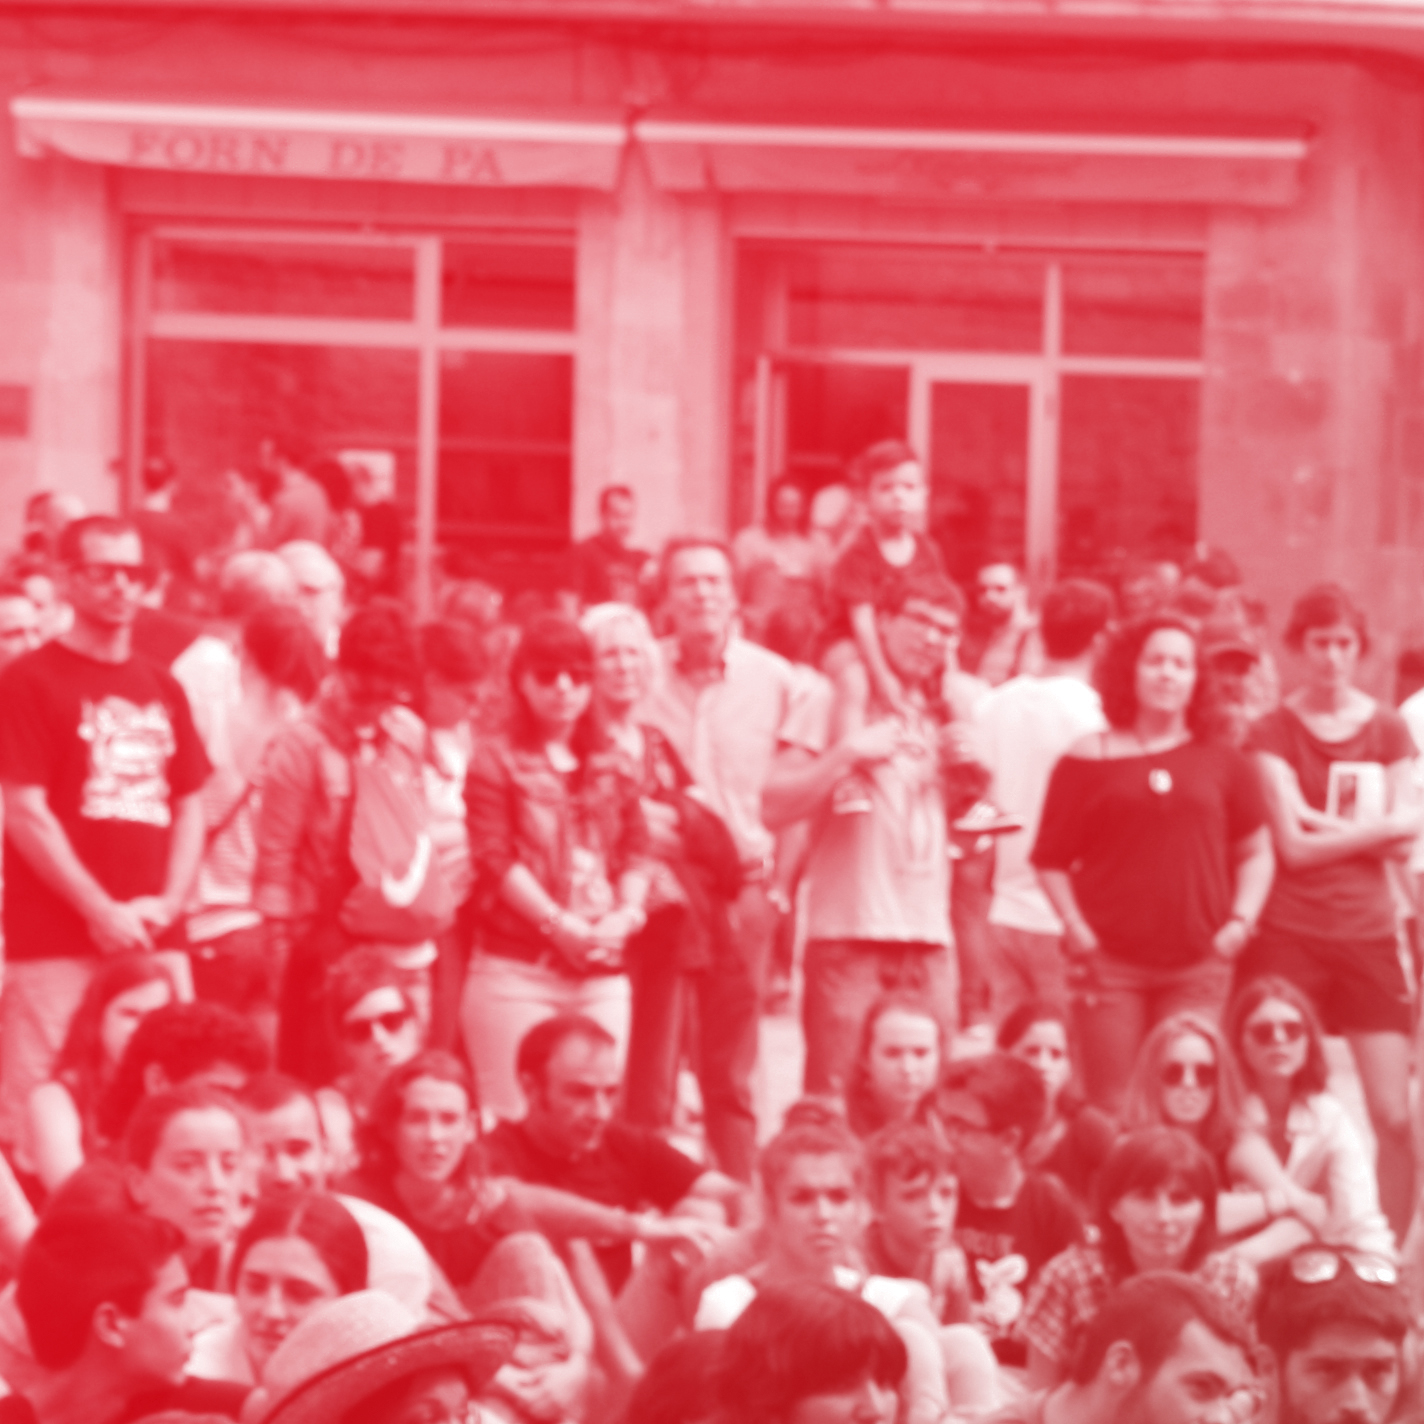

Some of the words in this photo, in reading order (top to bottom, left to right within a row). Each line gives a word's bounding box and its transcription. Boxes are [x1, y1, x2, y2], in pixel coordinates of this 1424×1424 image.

[129, 129, 288, 172] FORN
[330, 140, 404, 177] DE
[442, 144, 504, 185] PA
